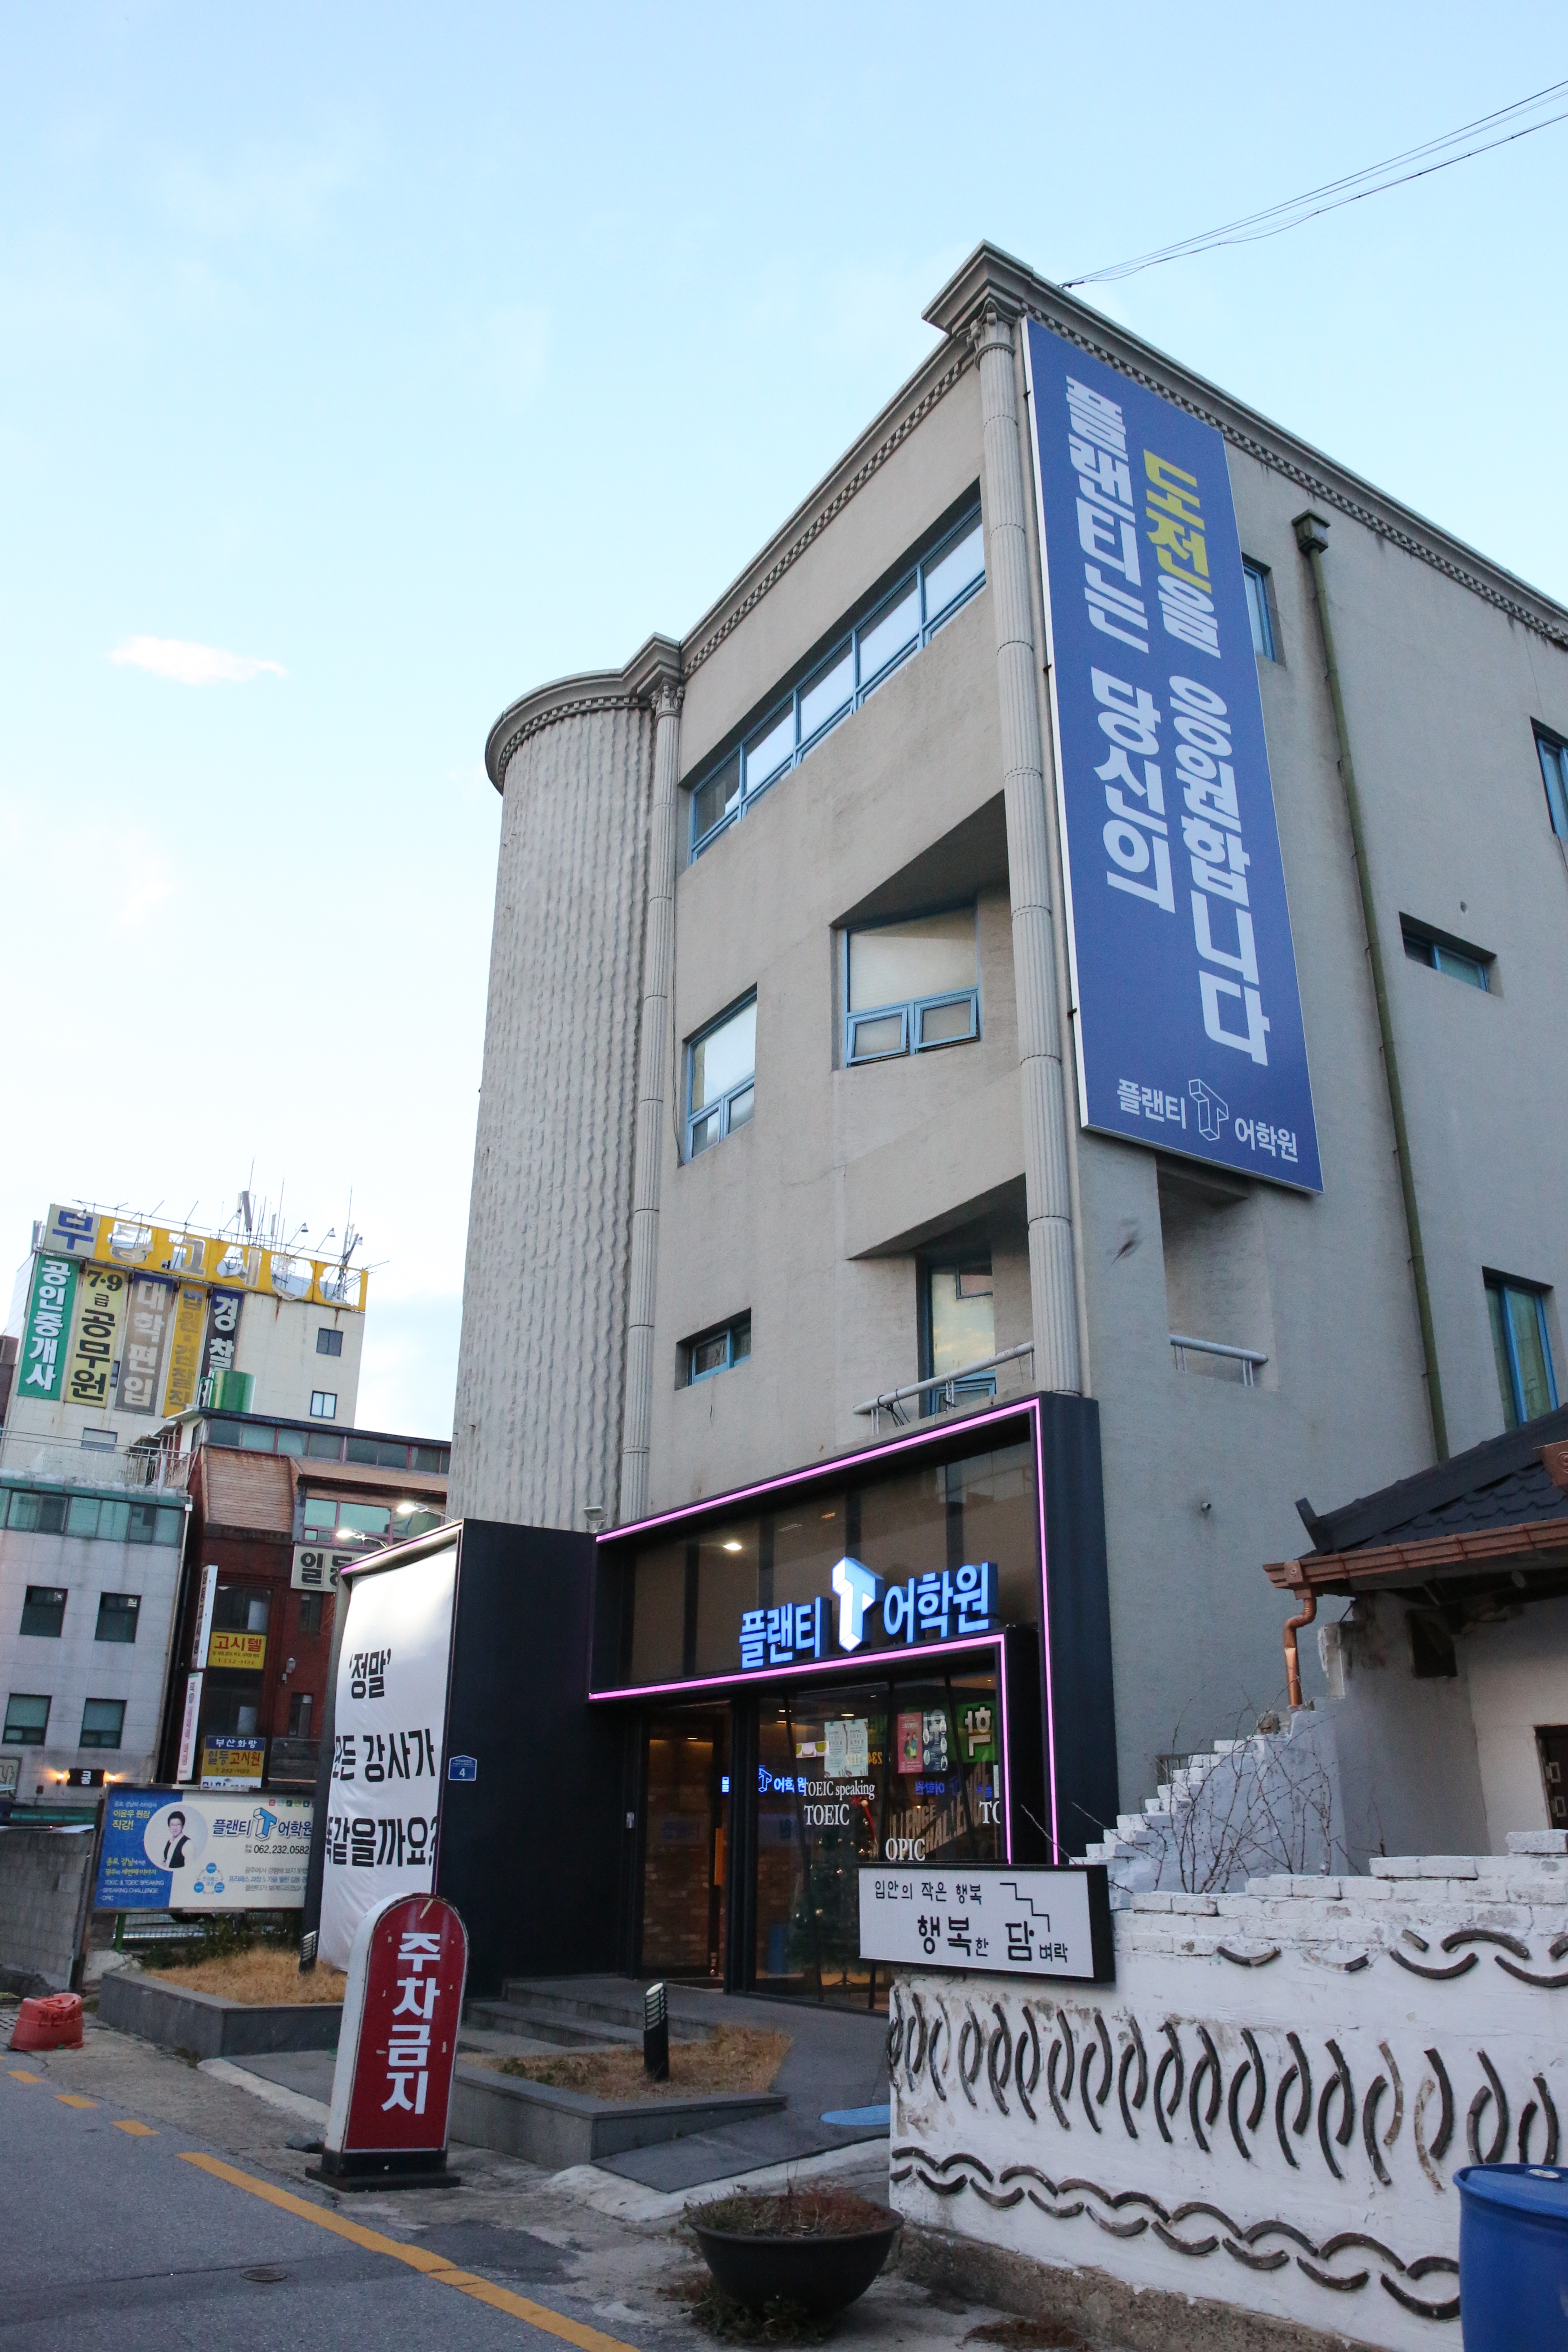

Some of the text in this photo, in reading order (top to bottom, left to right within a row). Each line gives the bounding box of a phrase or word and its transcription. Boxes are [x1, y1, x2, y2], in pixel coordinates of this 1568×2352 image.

[1066, 375, 1175, 913] 플랜티는 당신의
[1143, 449, 1268, 1066] 도전을 응원합니다
[1117, 1078, 1186, 1129] 플랜티
[1234, 1118, 1298, 1163] 어학원
[25, 1260, 71, 1391] 공인중개사
[124, 1281, 166, 1408] 대학편입
[739, 1597, 821, 1669] 플랜티
[884, 1562, 989, 1644] 어학원
[214, 1635, 262, 1653] 고시텔
[216, 1738, 257, 1748] 부산화랑
[363, 1728, 436, 1782] 강사가
[459, 1768, 466, 1777] 4
[803, 1779, 875, 1801] TOEIC speaking
[112, 1820, 134, 1831] 직강!
[136, 1810, 151, 1818] 원장
[804, 1804, 850, 1826] TOEIC
[213, 1819, 252, 1835] 플랜티
[278, 1821, 312, 1837] 어학원
[254, 1845, 310, 1854] 062.232.0582
[885, 1838, 926, 1861] OPIC
[875, 1880, 982, 1905] 입안의 작은 행복
[918, 1915, 1068, 1963] 행복한 담벼락
[381, 1932, 441, 2114] 주차금지
